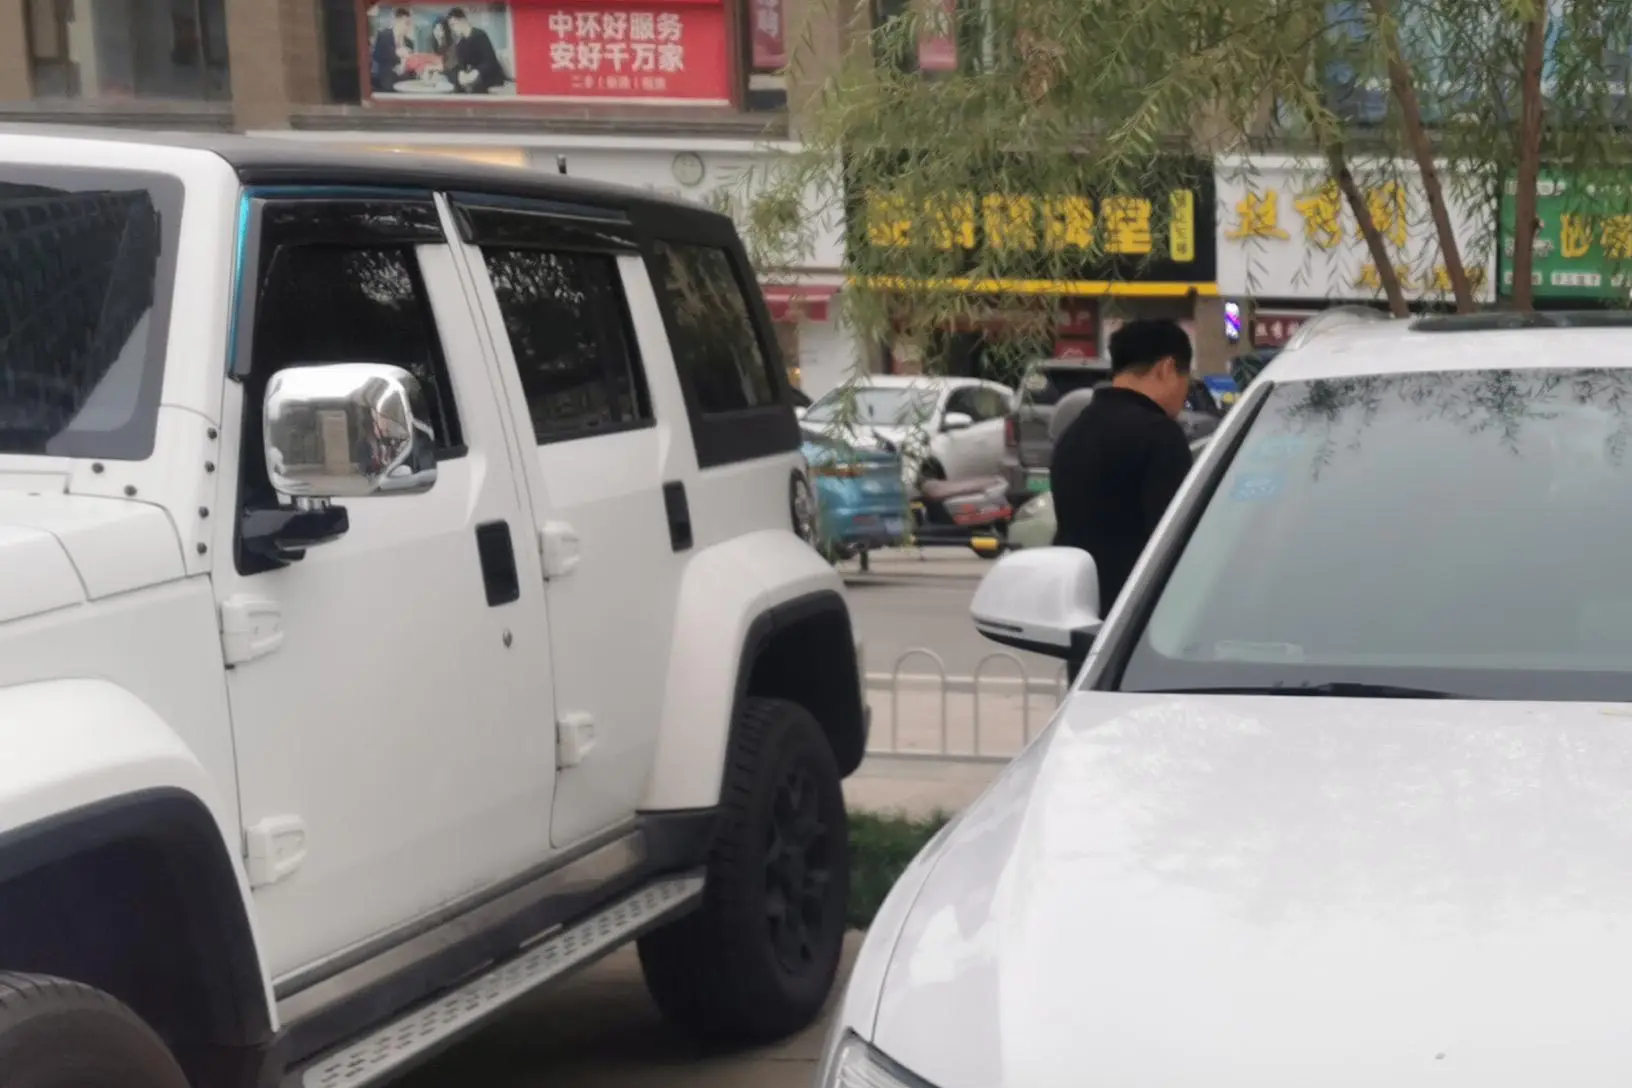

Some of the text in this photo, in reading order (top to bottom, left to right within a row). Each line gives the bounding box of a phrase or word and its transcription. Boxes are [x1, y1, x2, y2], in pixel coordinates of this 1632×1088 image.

[549, 11, 684, 41] 中环好服务
[550, 40, 684, 72] 安好千万家
